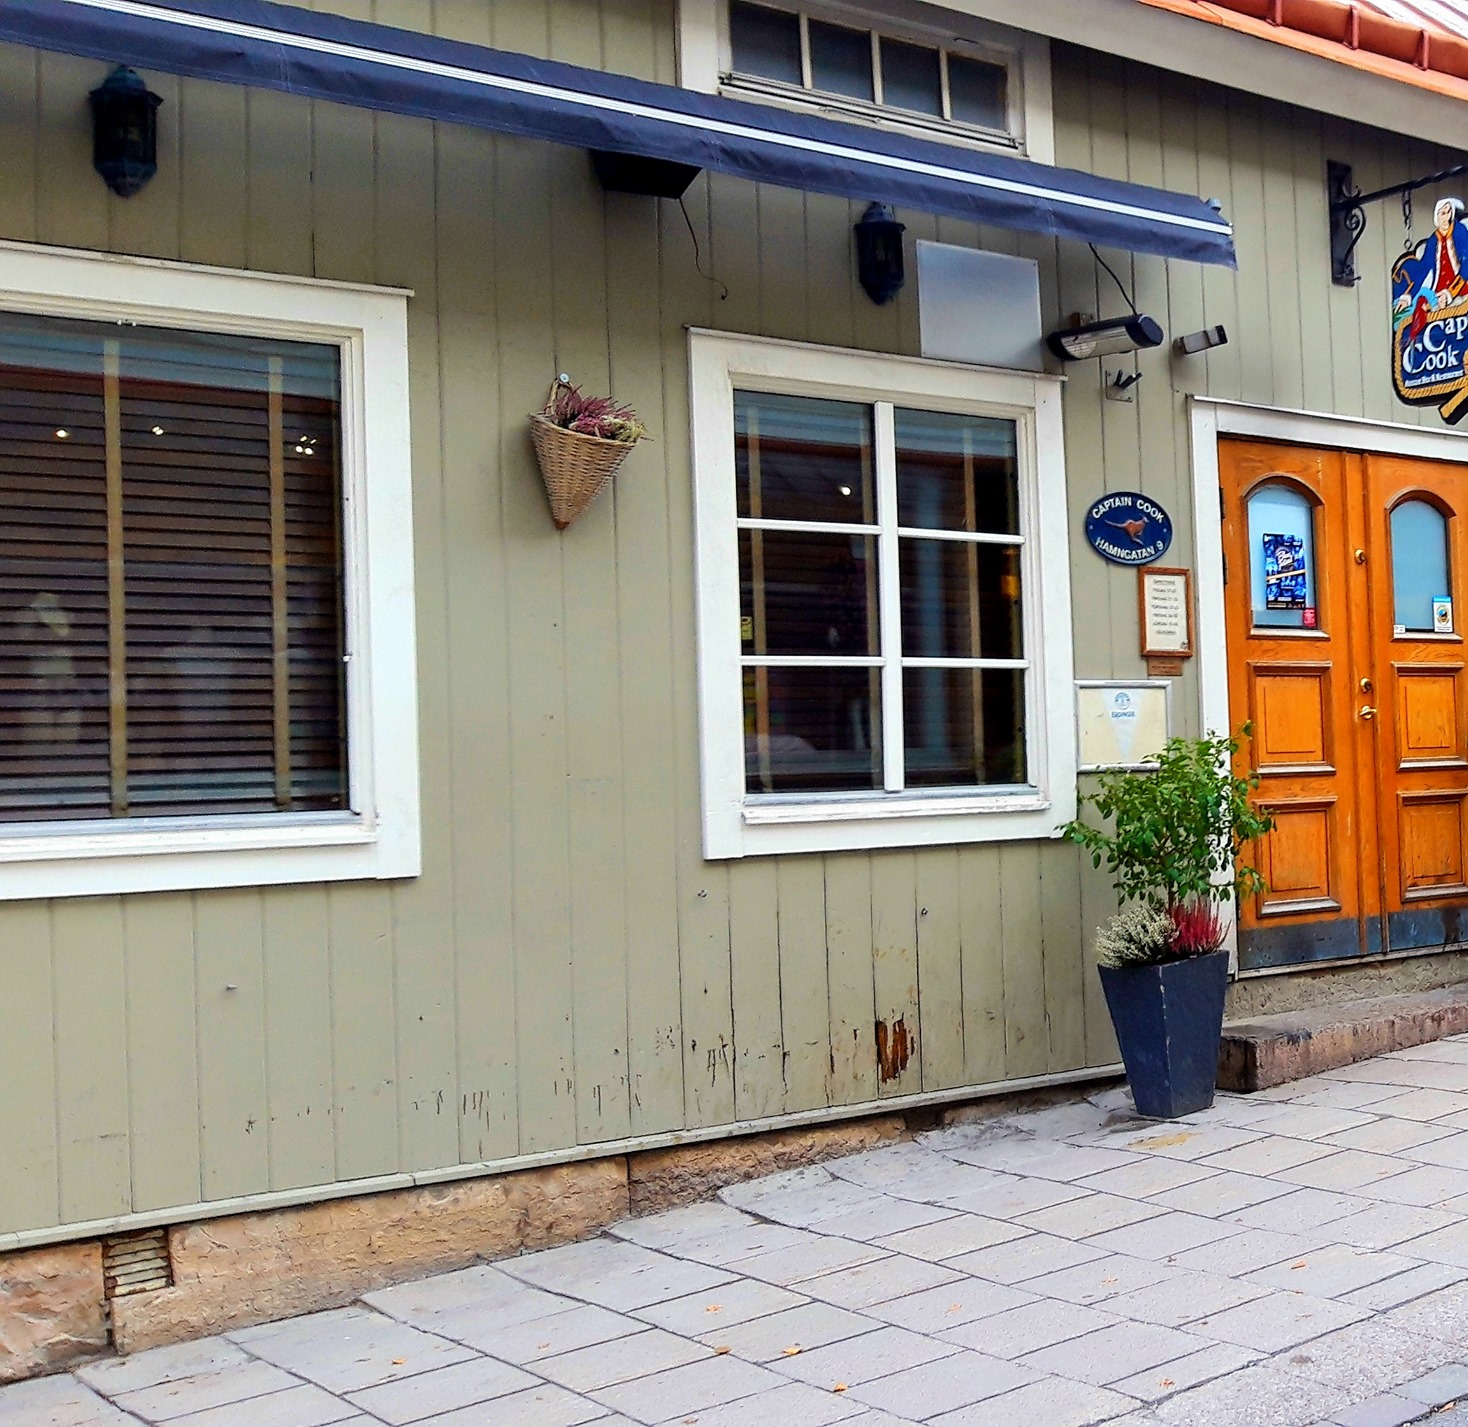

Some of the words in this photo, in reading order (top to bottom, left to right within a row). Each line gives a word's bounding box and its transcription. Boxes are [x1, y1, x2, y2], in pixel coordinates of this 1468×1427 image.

[1402, 343, 1460, 374] Cook
[1092, 496, 1132, 519] CAPTAIN
[1136, 499, 1164, 523] COOK
[1095, 536, 1155, 560] HAMNGATAN
[1156, 540, 1164, 551] 9
